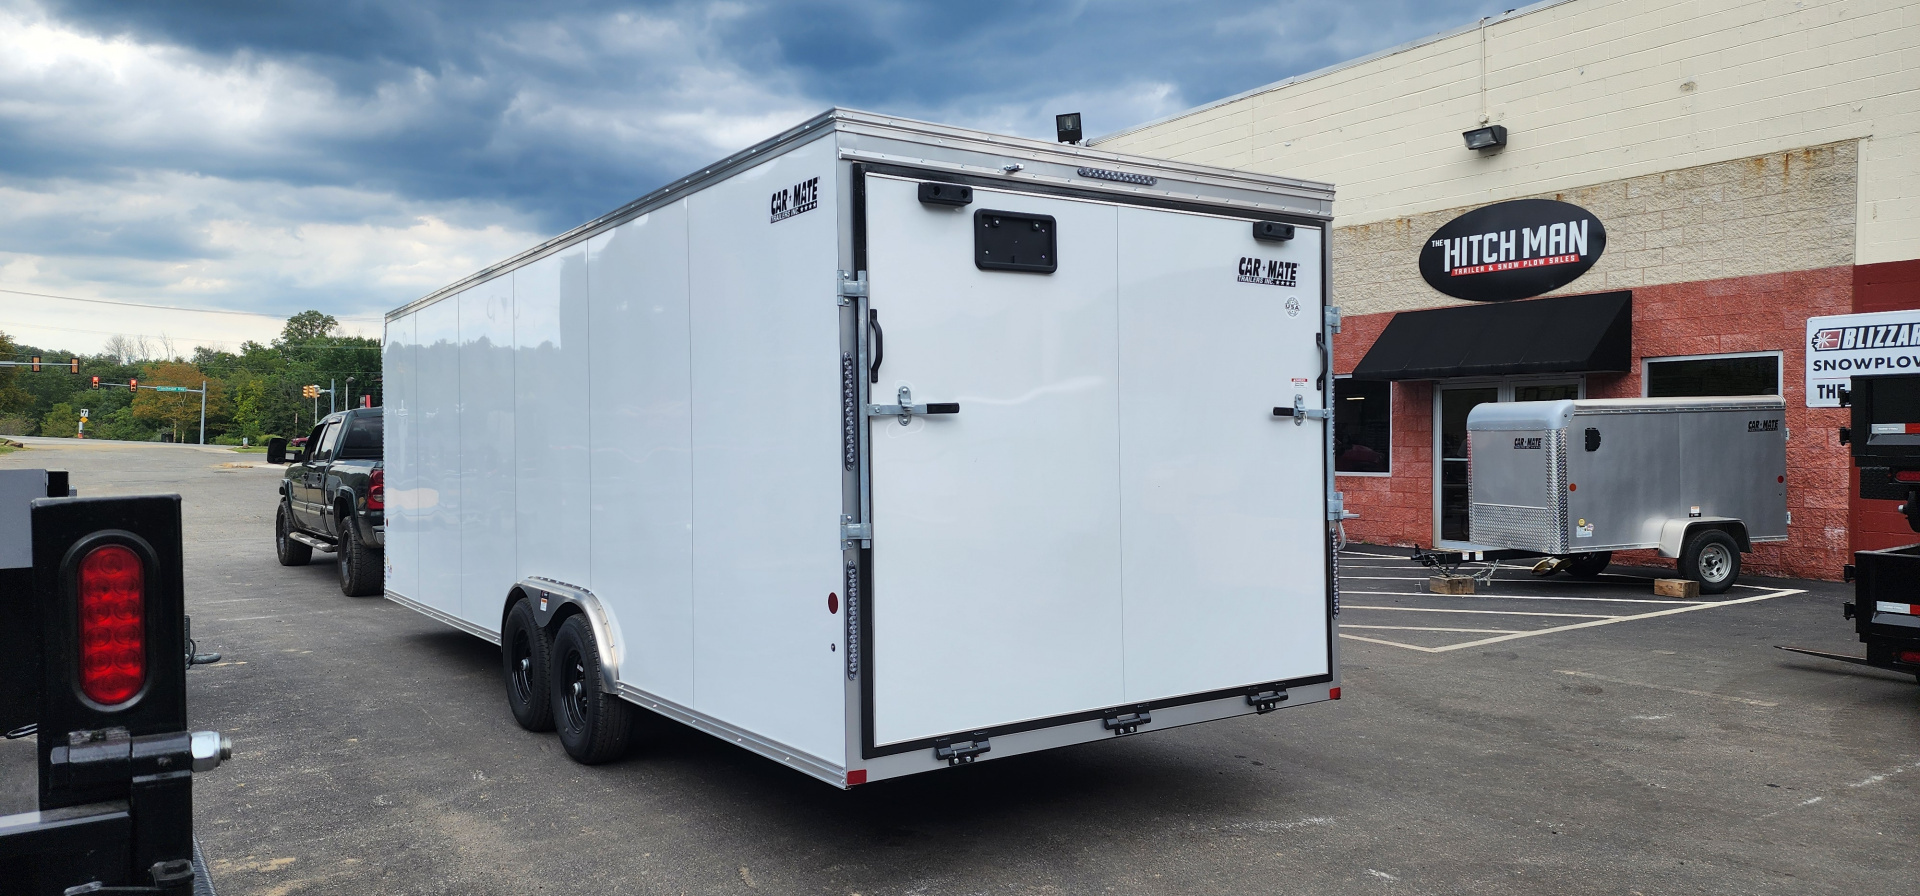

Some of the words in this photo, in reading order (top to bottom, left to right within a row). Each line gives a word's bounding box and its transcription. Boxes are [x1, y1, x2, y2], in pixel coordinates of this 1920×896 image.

[771, 189, 788, 215] CAR
[793, 177, 818, 207] MATE
[1432, 239, 1443, 247] THE
[1444, 229, 1516, 272] HITCH
[1522, 219, 1588, 259] MAN
[1239, 257, 1261, 276] CAR
[1267, 260, 1297, 280] MATE
[1454, 265, 1485, 275] TRAILER
[1498, 261, 1519, 270] SNOW
[1523, 258, 1545, 267] PLOW
[1549, 255, 1575, 264] SALES
[1238, 275, 1263, 284] TRAILERS
[1748, 420, 1760, 430] CAR
[1763, 419, 1779, 429] MATE
